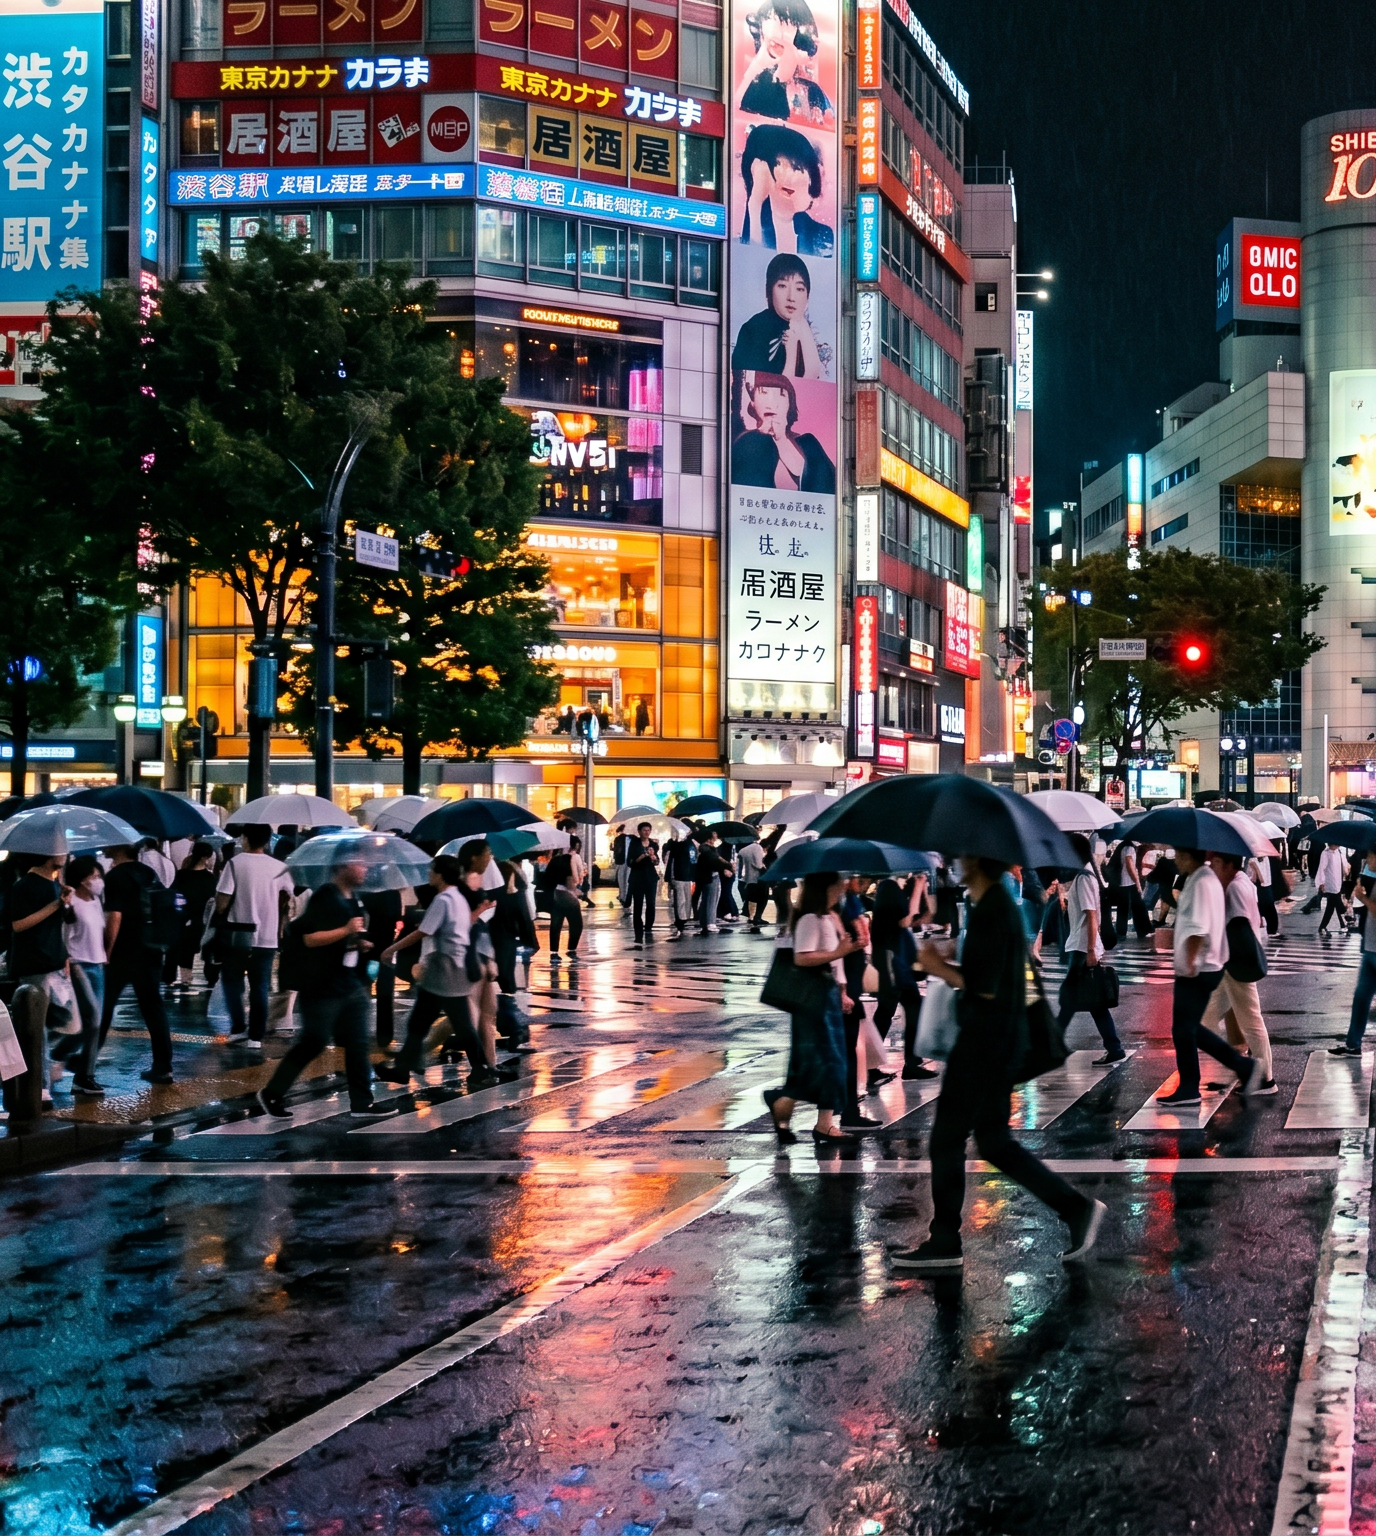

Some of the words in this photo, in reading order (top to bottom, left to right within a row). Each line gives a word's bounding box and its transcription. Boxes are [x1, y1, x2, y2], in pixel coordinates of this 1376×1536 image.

[484, 0, 673, 61] ラーメン
[220, 65, 338, 90] 東京カナナ
[500, 66, 617, 108] 東京カナナ
[227, 109, 368, 155] 居酒屋
[533, 115, 671, 177] 居酒屋
[1, 52, 53, 272] 渋谷駅
[59, 46, 90, 269] カタカナナ集
[1249, 273, 1297, 298] QLO
[740, 568, 825, 601] 居酒屋
[745, 610, 820, 633] ラーメン
